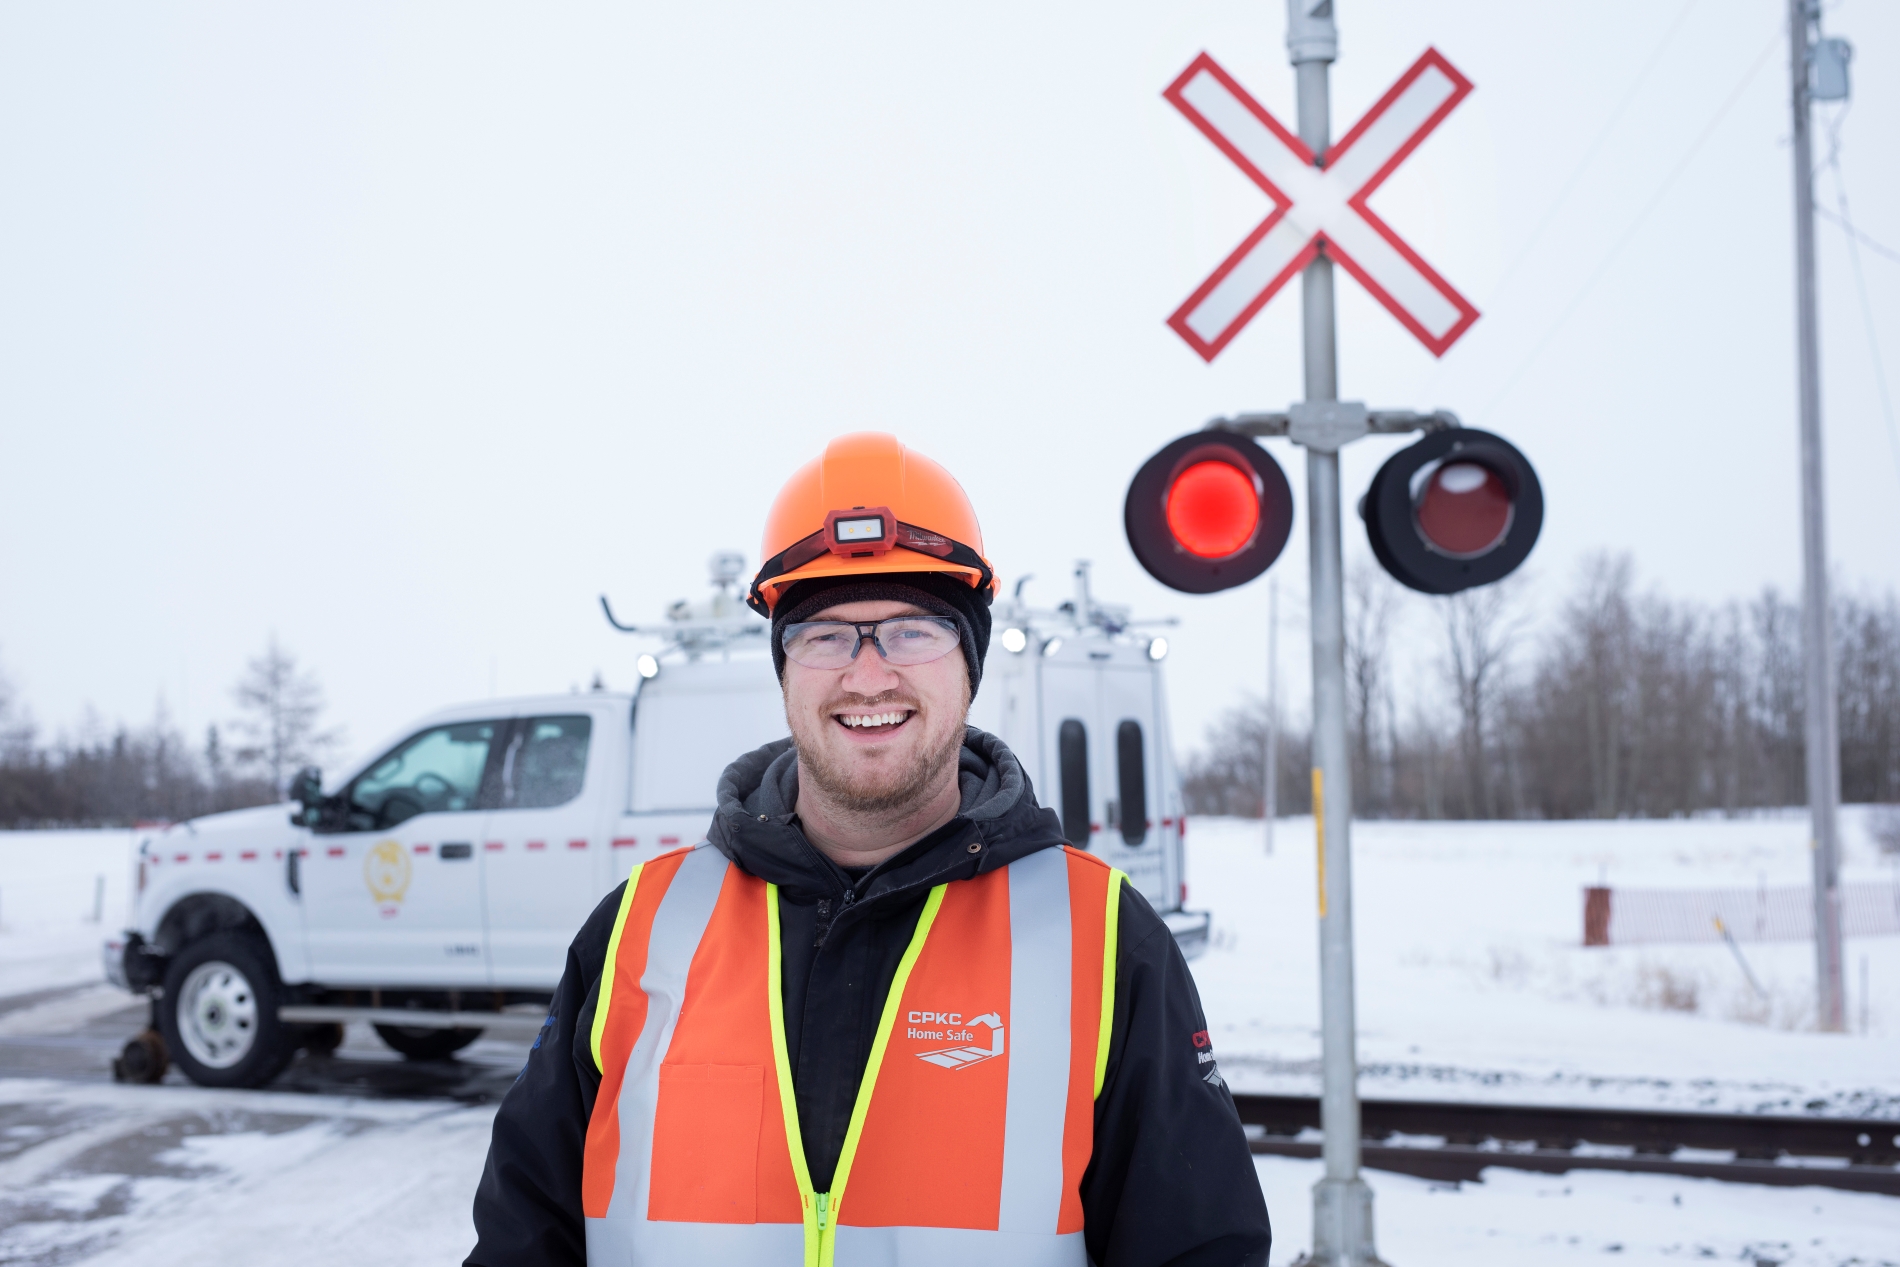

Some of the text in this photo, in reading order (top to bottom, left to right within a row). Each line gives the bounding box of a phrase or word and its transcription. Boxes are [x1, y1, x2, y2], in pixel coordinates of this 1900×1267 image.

[908, 1011, 962, 1025] CPKC
[907, 1027, 974, 1042] Home Safe
